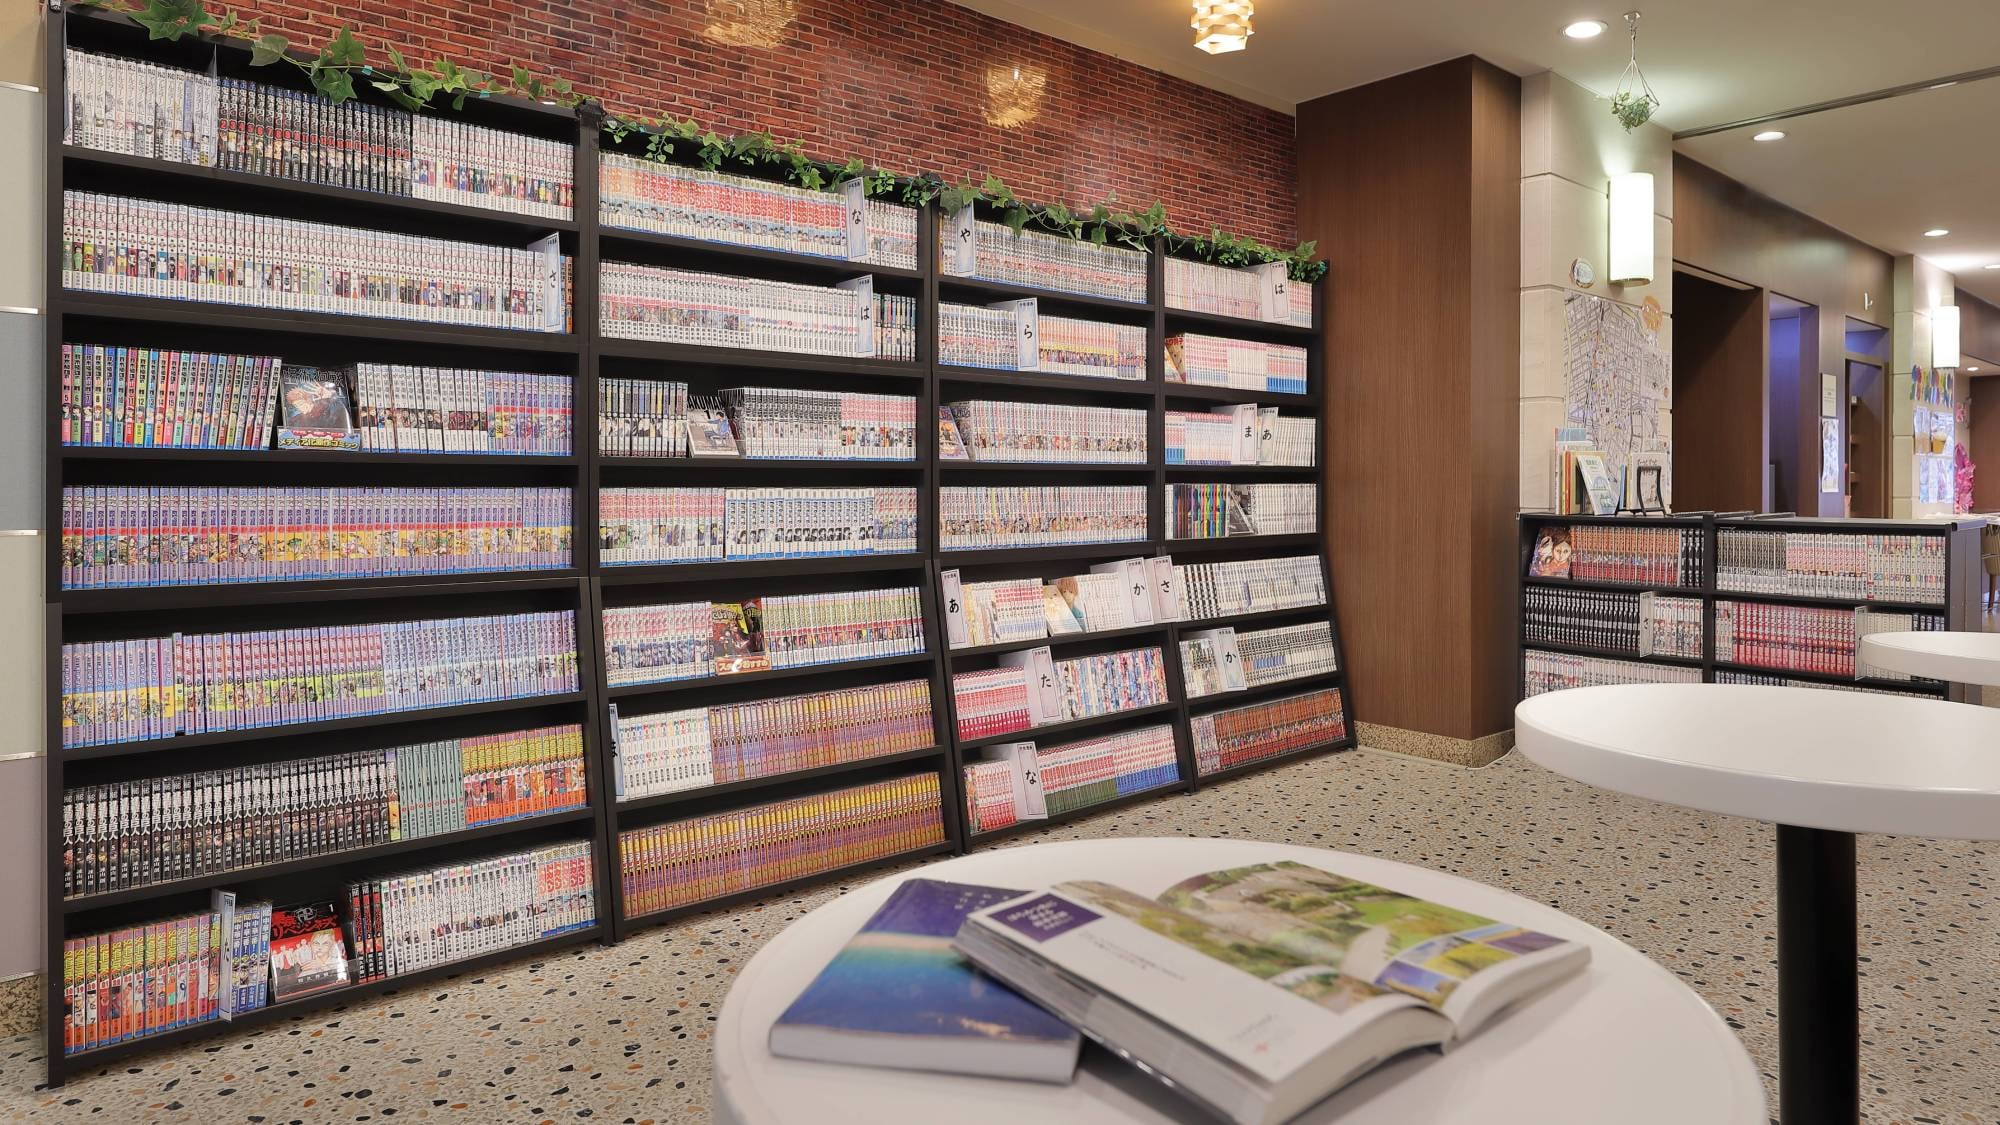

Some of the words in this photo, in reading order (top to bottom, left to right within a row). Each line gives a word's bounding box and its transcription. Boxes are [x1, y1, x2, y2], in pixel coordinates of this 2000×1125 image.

[852, 209, 861, 224] な
[960, 228, 970, 243] や
[1274, 283, 1284, 295] は
[861, 306, 870, 320] は
[1024, 324, 1032, 338] ら
[704, 410, 710, 419] 1
[1245, 426, 1252, 438] ま
[1263, 430, 1272, 440] あ
[1134, 582, 1144, 596] か
[1161, 580, 1170, 593] さ
[949, 598, 959, 613] あ
[1225, 651, 1236, 663] か
[1041, 674, 1051, 688] た
[611, 741, 617, 757] ま
[1026, 770, 1036, 784] な
[329, 904, 334, 912] 1
